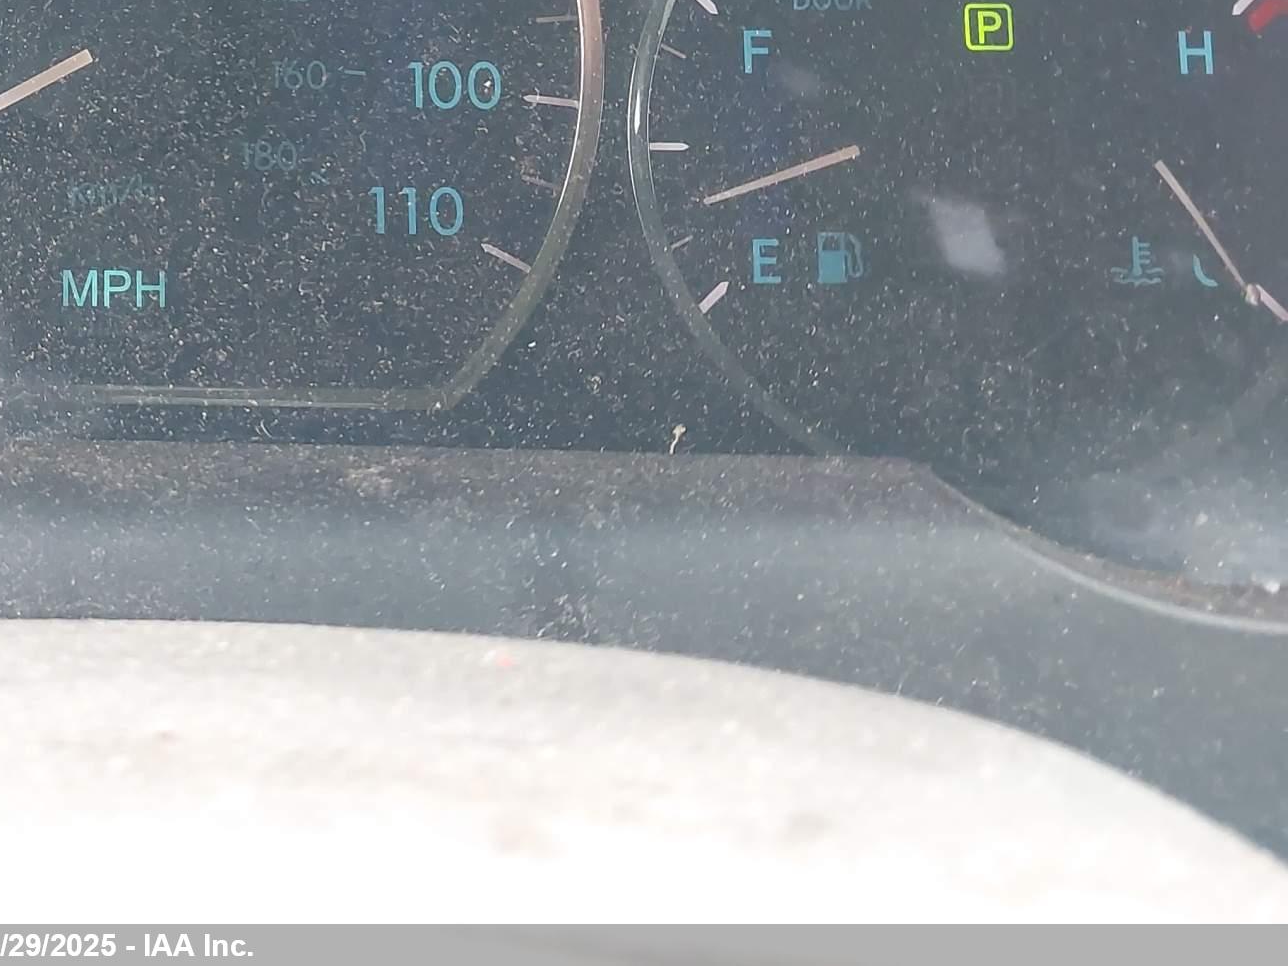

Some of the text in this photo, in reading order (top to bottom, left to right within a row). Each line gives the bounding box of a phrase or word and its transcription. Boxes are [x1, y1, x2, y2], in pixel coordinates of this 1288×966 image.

[977, 10, 1002, 45] P
[743, 28, 772, 74] F
[1178, 30, 1214, 75] H
[272, 59, 328, 90] 160
[408, 60, 502, 111] 100
[242, 140, 297, 172] 180
[369, 185, 464, 236] 110
[753, 238, 782, 284] E
[61, 268, 167, 307] MPH
